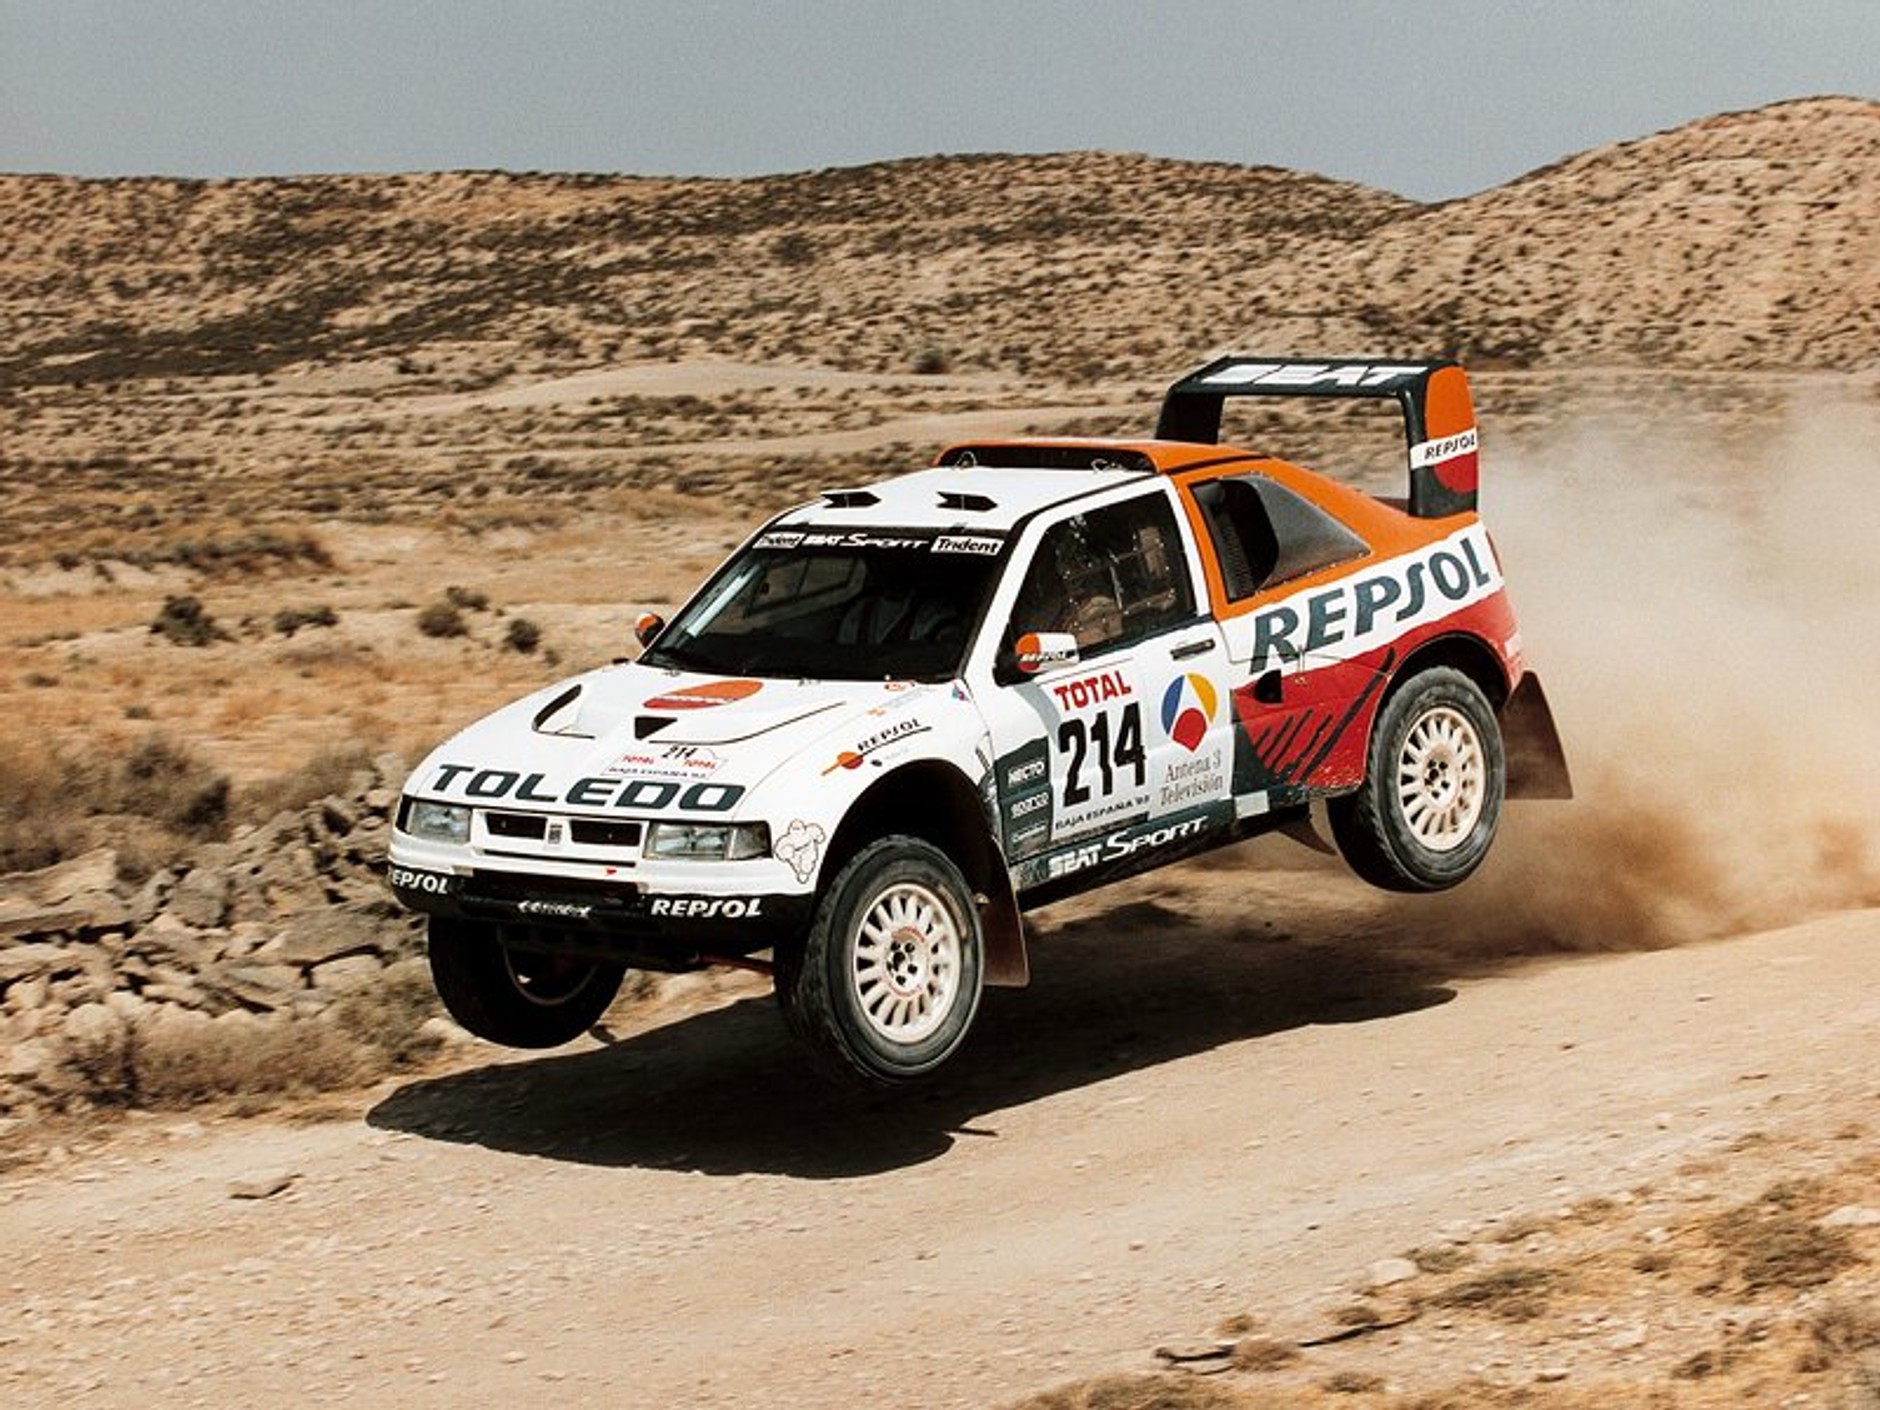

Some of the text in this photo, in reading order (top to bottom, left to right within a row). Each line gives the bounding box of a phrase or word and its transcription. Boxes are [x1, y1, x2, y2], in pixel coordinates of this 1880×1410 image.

[1201, 363, 1429, 386] SEAT
[1424, 434, 1476, 460] REPSOL
[937, 537, 999, 554] Trident
[1249, 537, 1490, 676] REPSOL
[1054, 670, 1132, 711] TOTAL
[858, 718, 921, 751] REPSOL
[1057, 702, 1146, 807] 214
[1165, 748, 1220, 783] Antena 3
[432, 763, 747, 812] TOLEDO
[1160, 774, 1223, 806] Televisión
[1055, 814, 1084, 830] BAJA
[1048, 815, 1208, 878] SEAT SPORT
[651, 898, 762, 919] REPSOL
